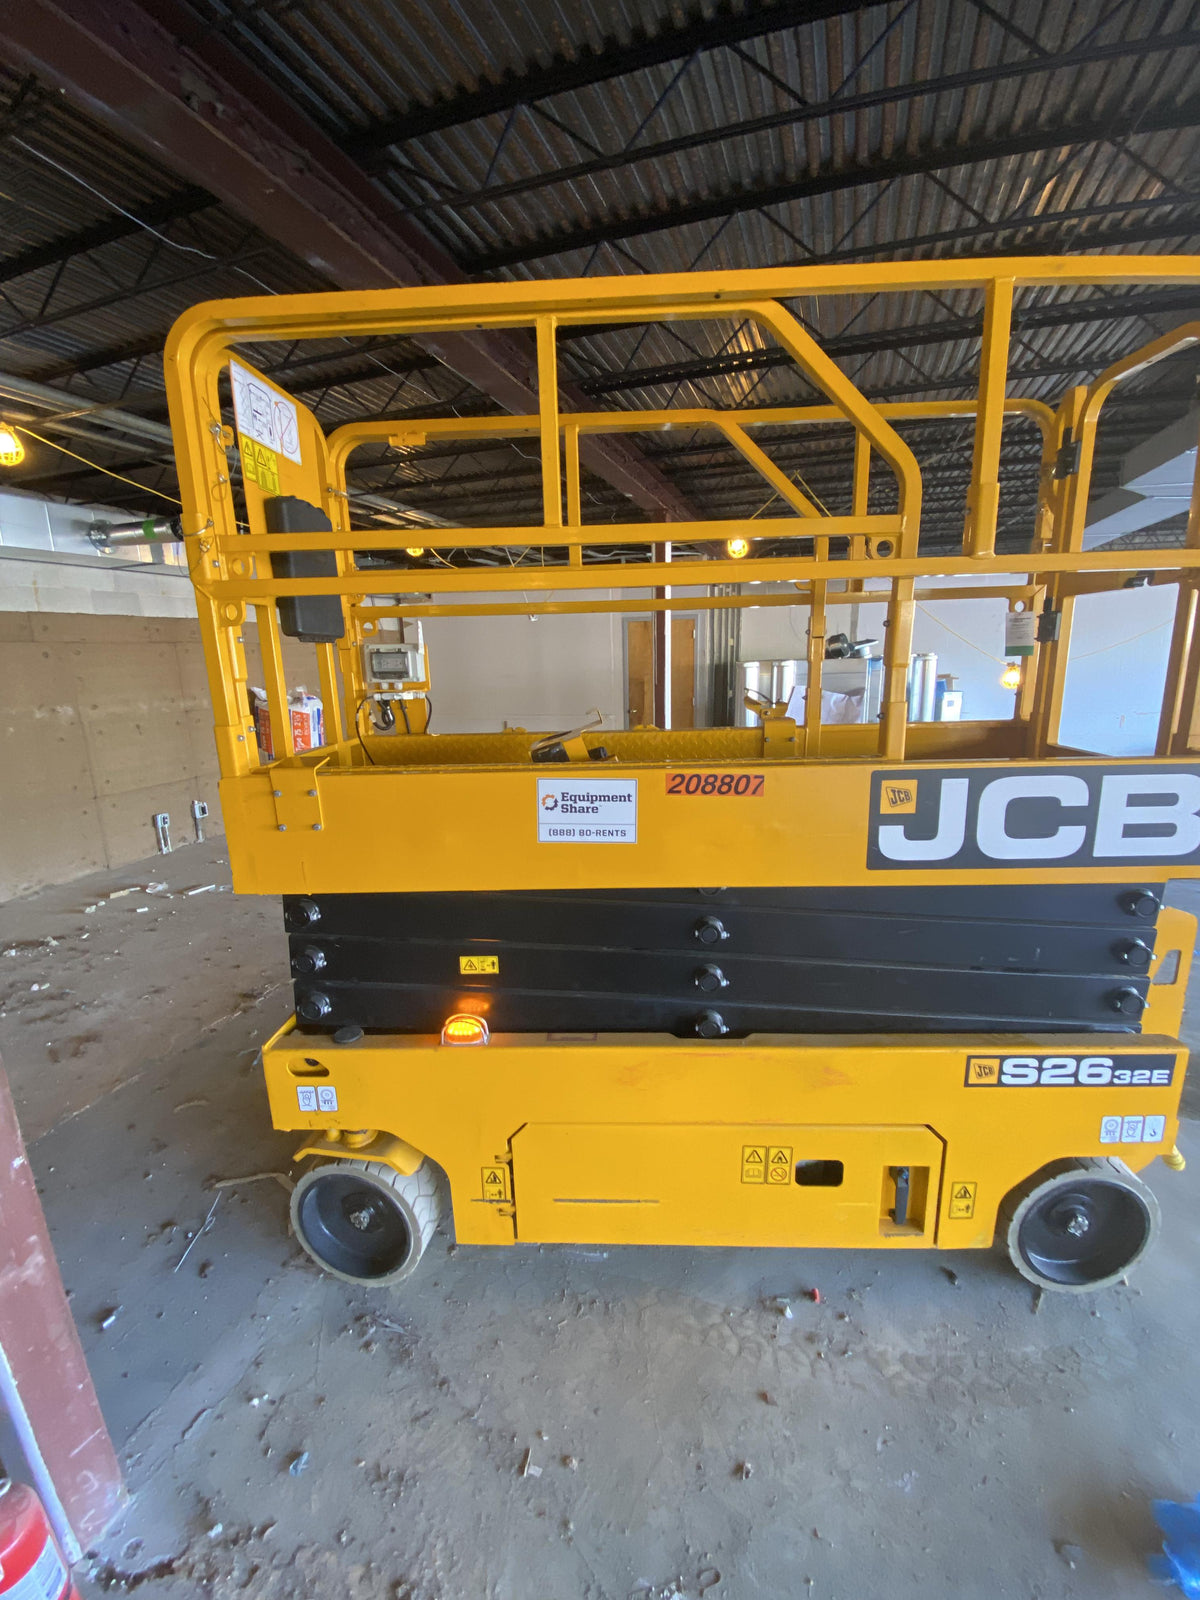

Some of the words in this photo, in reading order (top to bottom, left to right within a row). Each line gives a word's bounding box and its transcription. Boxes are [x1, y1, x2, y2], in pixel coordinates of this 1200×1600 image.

[667, 773, 765, 795] 208807
[561, 792, 633, 804] Equipment
[890, 788, 911, 805] JCB
[561, 804, 599, 814] Share
[878, 773, 1200, 861] JCB
[548, 828, 576, 837] (888)
[578, 828, 627, 837] 80-RENTS
[977, 1065, 994, 1078] JCB
